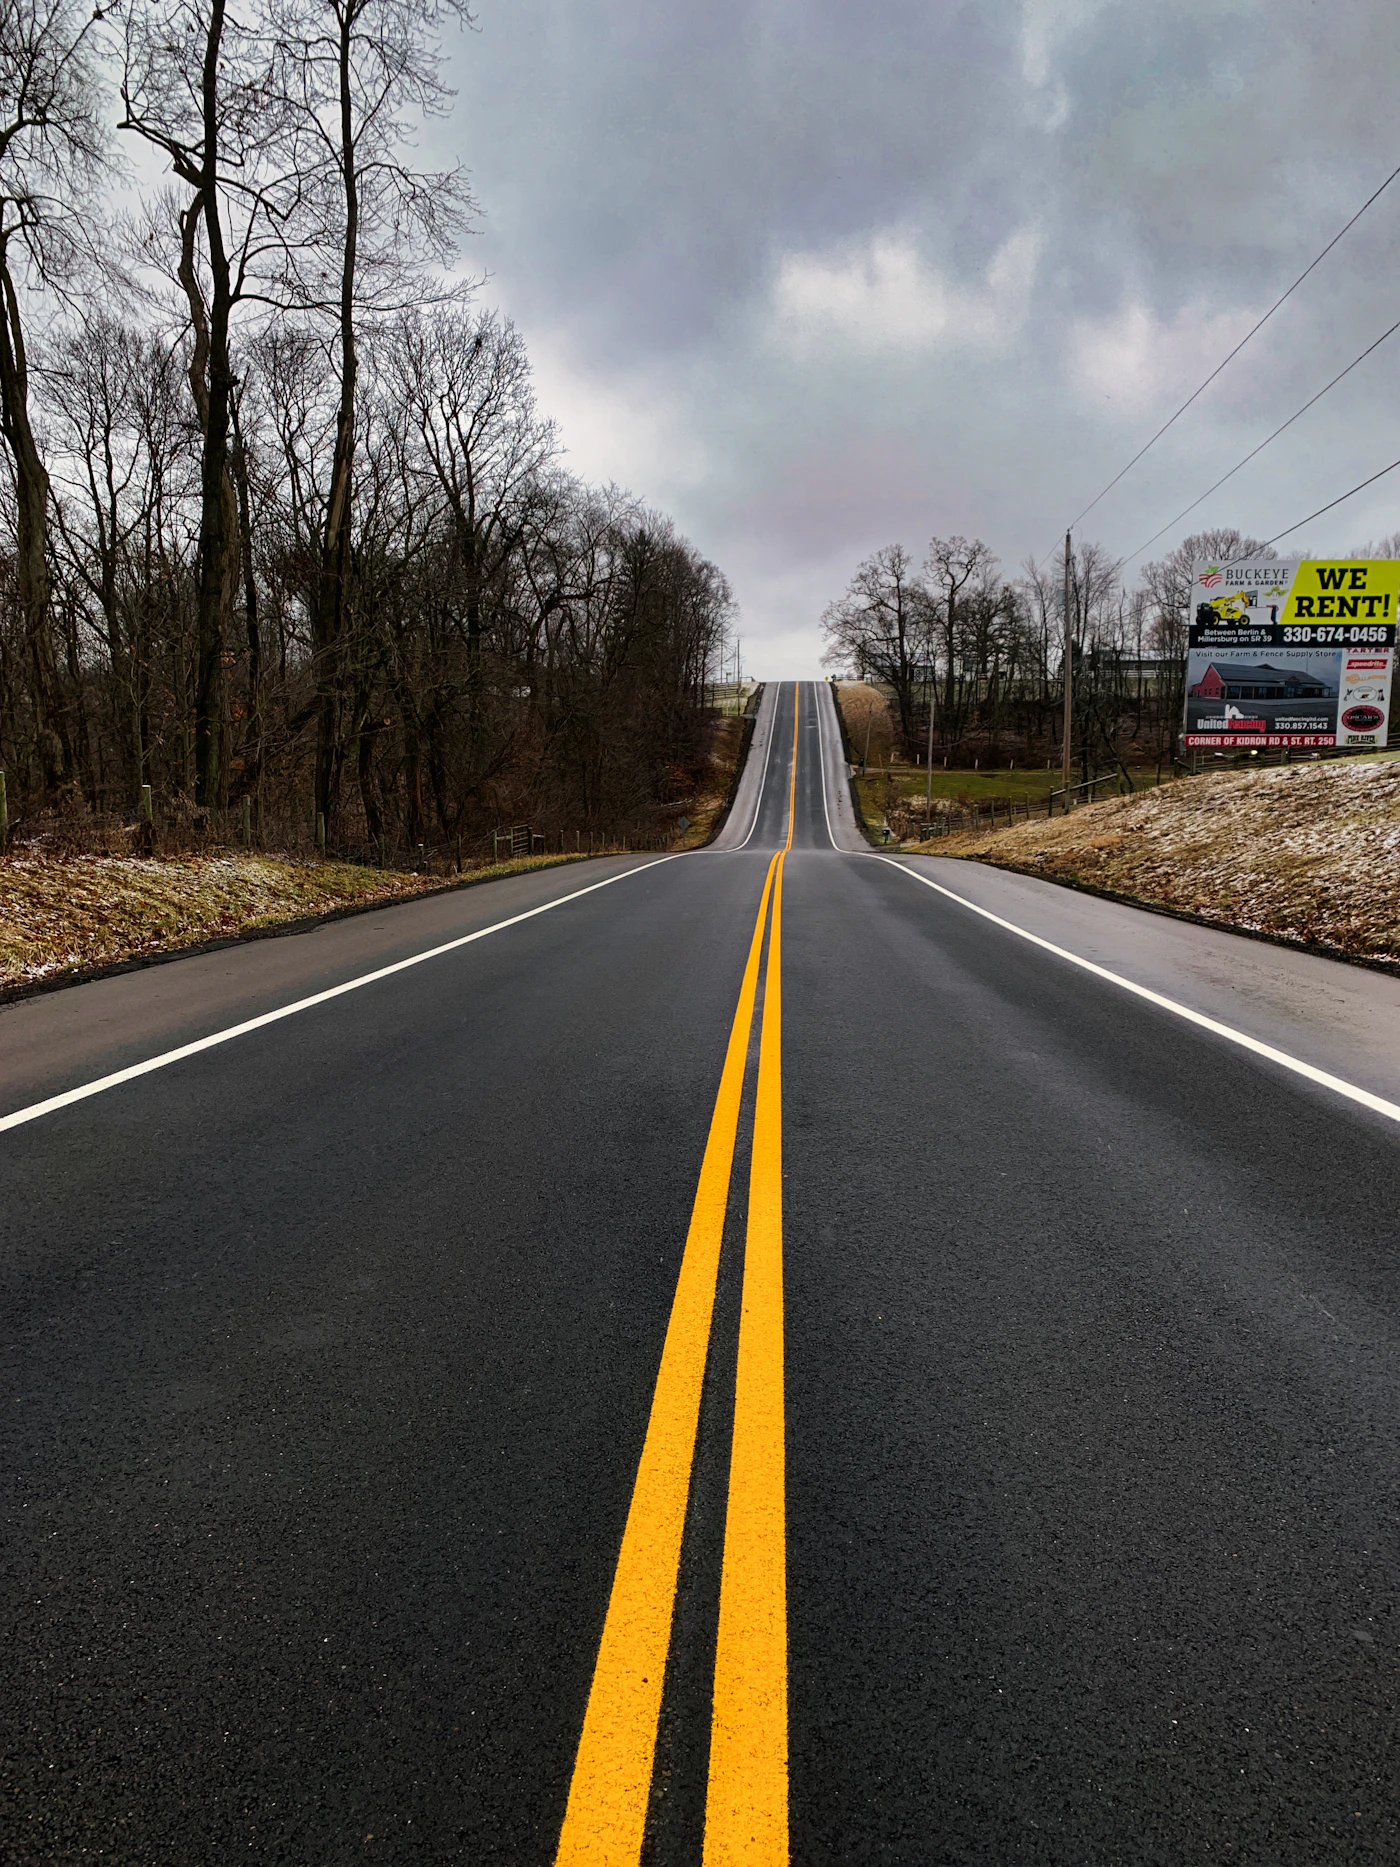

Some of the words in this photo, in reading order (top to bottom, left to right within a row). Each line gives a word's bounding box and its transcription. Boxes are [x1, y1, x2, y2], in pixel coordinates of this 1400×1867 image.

[1226, 568, 1289, 580] BUCKEYE
[1316, 568, 1368, 590] WE
[1294, 594, 1391, 618] RENT!
[1197, 635, 1238, 643] Millersburg
[1283, 626, 1387, 643] 330-674-0456
[1350, 660, 1384, 668] speedrite
[1275, 722, 1328, 730] 330.857.1543
[1188, 736, 1222, 746] CORNER
[1224, 736, 1234, 745] OF
[1236, 736, 1267, 745] KIDRON
[1268, 736, 1280, 745] RD
[1282, 736, 1289, 745] &
[1291, 736, 1303, 745] ST.
[1304, 736, 1317, 745] RT.
[1318, 736, 1334, 745] 250
